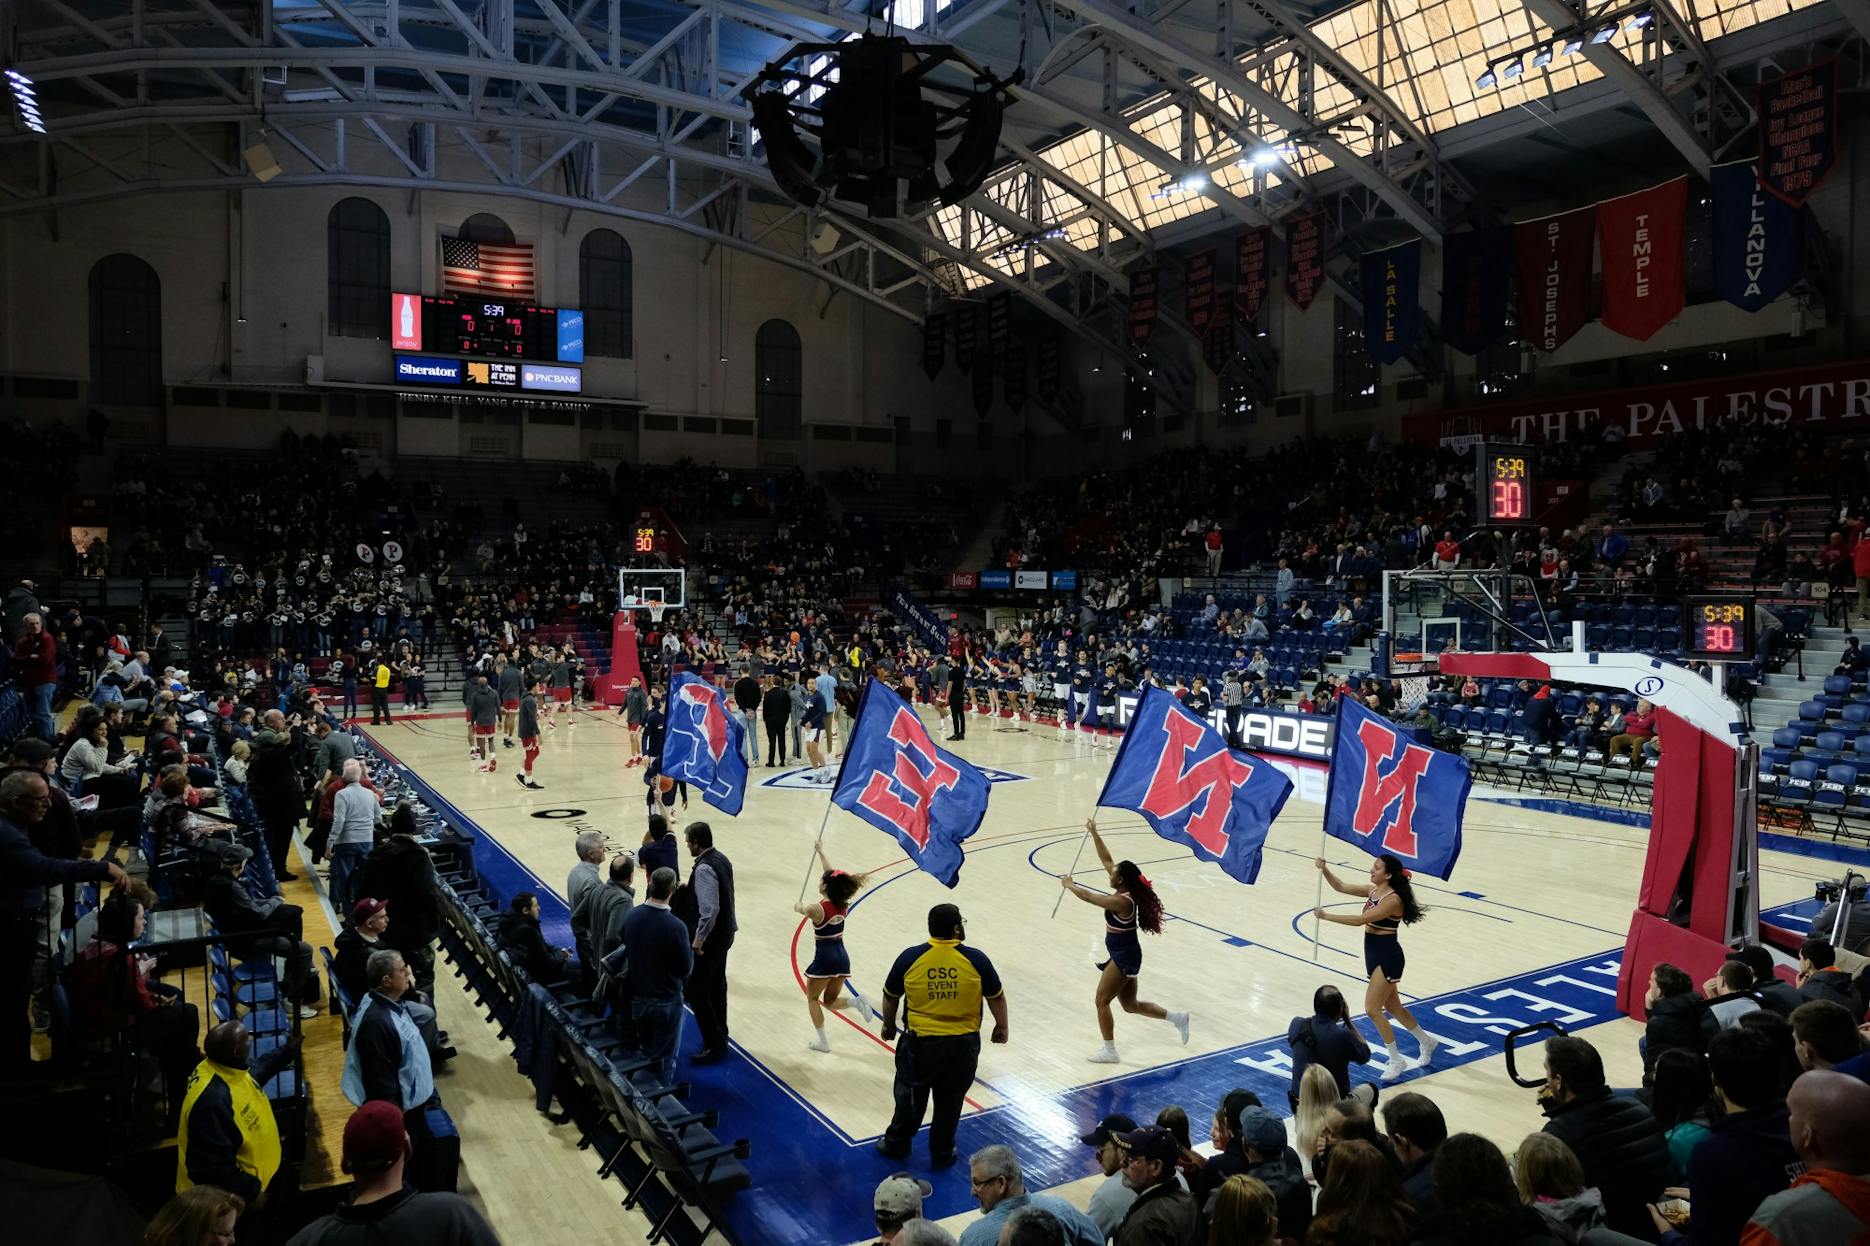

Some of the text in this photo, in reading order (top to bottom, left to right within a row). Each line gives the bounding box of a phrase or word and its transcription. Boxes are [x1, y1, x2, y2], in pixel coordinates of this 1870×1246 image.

[1633, 214, 1651, 298] TEMPLE
[1385, 259, 1397, 342] LA SALLE
[1543, 259, 1560, 351] JOSEPHS
[484, 305, 504, 316] 5:39
[399, 363, 457, 378] Sheraton
[490, 363, 516, 373] THE INN
[490, 373, 499, 381] AT
[398, 392, 438, 403] HENRY
[443, 395, 472, 405] KELL
[477, 397, 507, 408] YANG
[552, 401, 591, 413] FAMILY
[1496, 458, 1524, 479] 5:39
[1494, 481, 1521, 518] 30
[638, 528, 654, 537] 5:39
[636, 537, 652, 551] 30
[1704, 604, 1744, 623] 5:39
[1706, 626, 1733, 651] 30
[1611, 756, 1630, 764] PENN
[1789, 778, 1811, 787] PENN
[1821, 782, 1845, 790] PENN
[927, 967, 958, 980] CSC
[927, 981, 959, 990] EVENT
[928, 991, 959, 1000] STAFF
